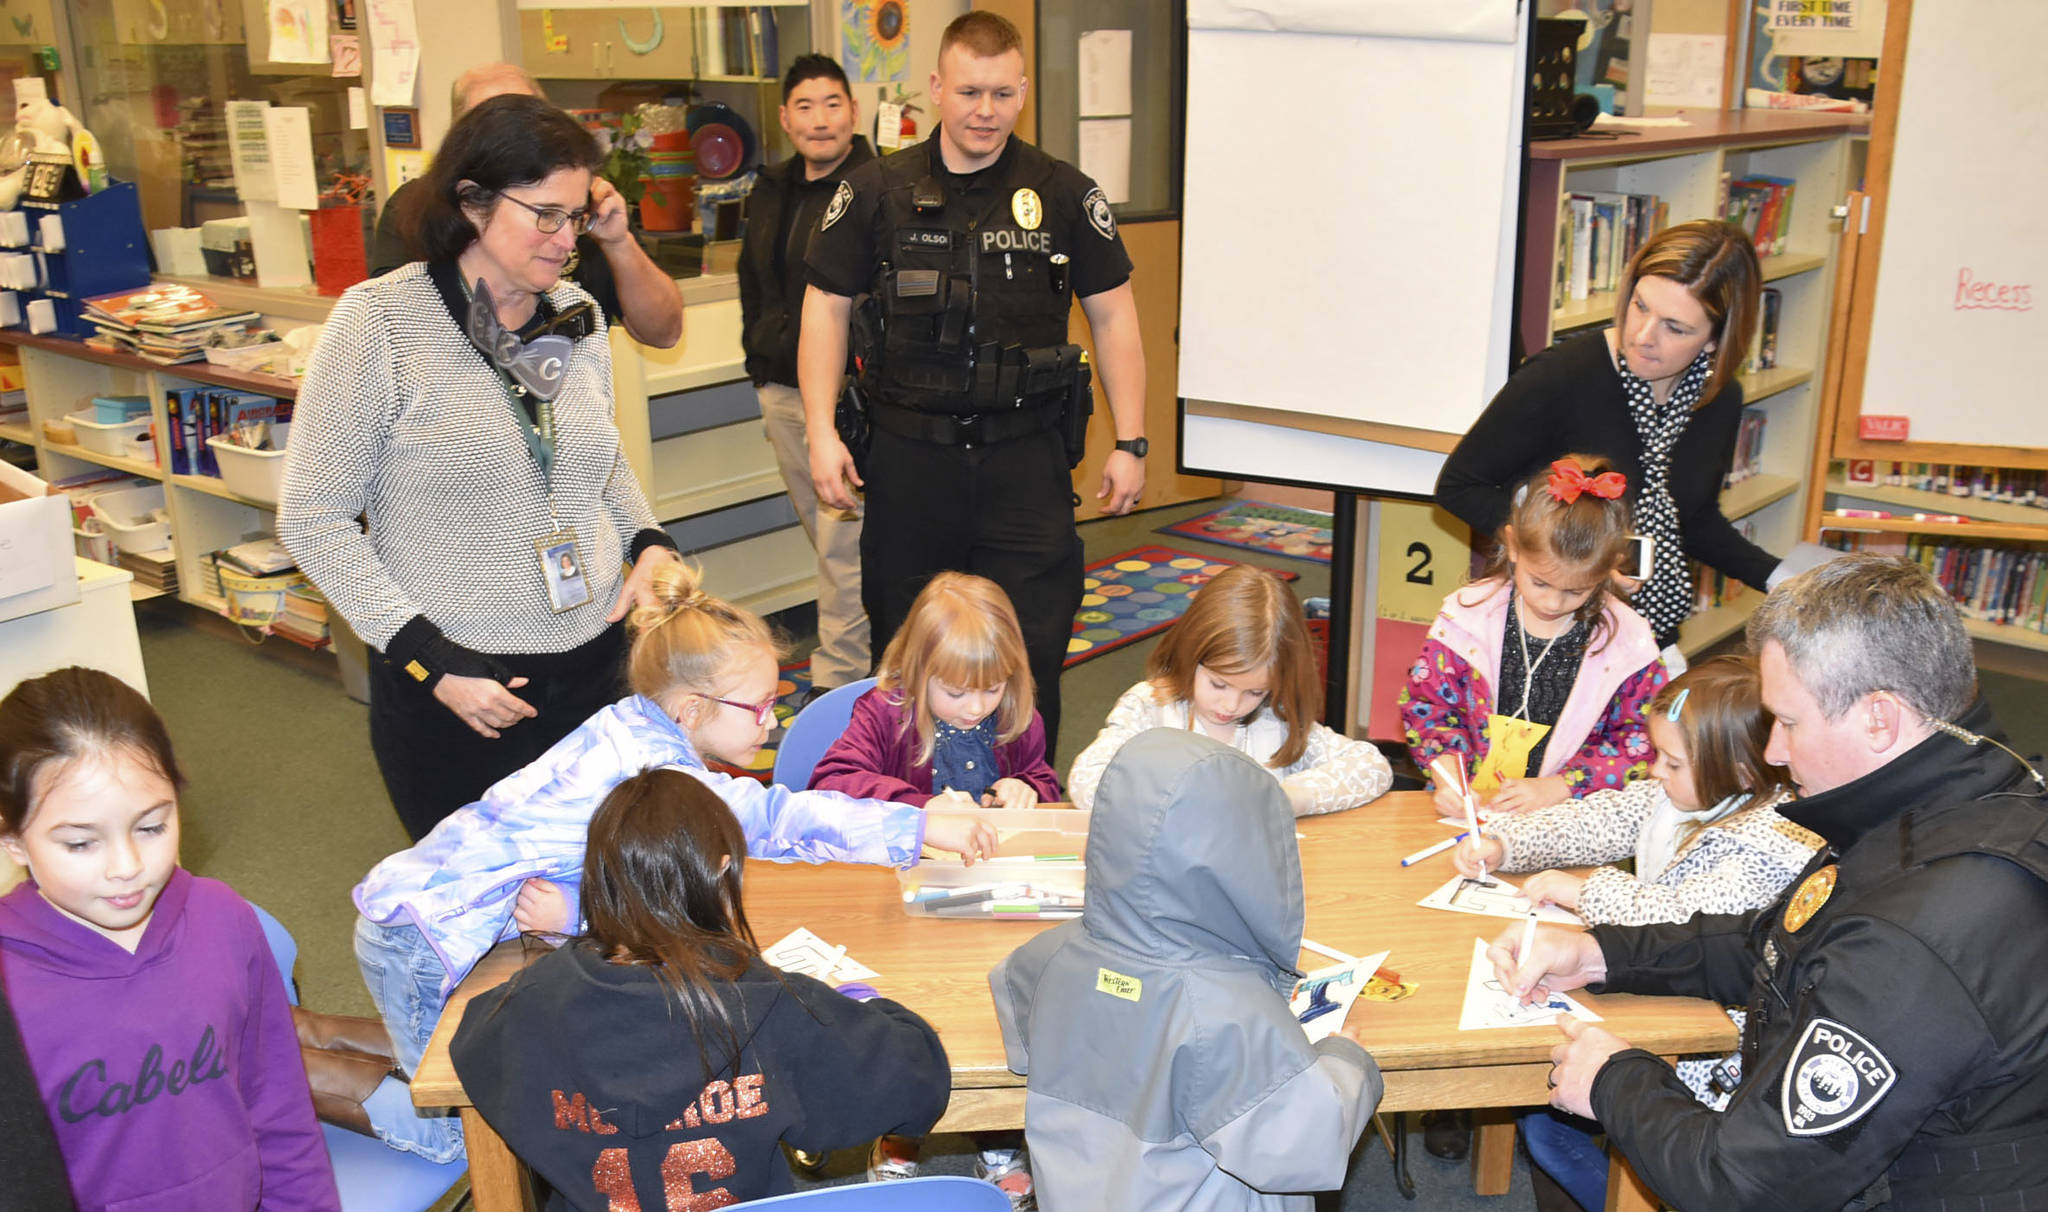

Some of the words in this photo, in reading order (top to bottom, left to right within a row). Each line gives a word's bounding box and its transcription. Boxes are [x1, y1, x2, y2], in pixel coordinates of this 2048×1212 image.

[1775, 14, 1816, 27] EVERY
[1822, 15, 1852, 28] TIME
[1778, 0, 1816, 12] FIRST
[1821, 1, 1851, 13] TIME
[909, 233, 918, 242] J.
[921, 233, 949, 244] OLSO
[982, 229, 1052, 252] POLICE
[1954, 266, 2033, 305] Recess
[1405, 541, 1434, 586] 2
[1812, 1027, 1887, 1087] POLICE
[551, 1073, 769, 1135] MOE
